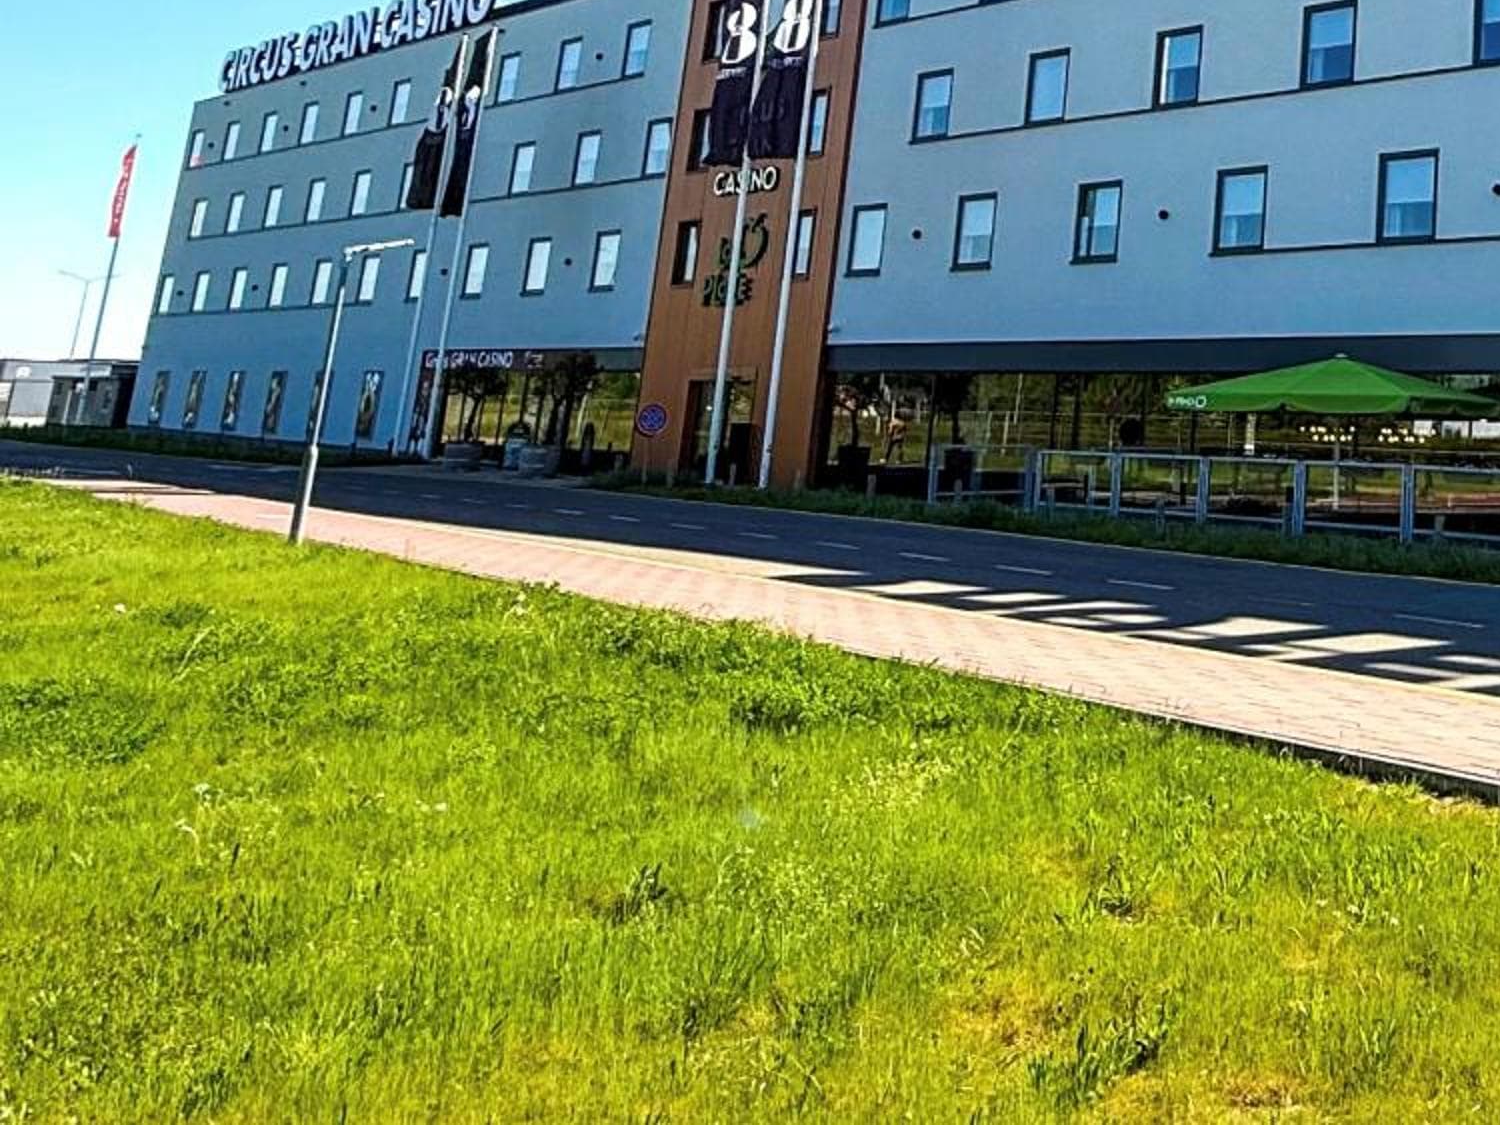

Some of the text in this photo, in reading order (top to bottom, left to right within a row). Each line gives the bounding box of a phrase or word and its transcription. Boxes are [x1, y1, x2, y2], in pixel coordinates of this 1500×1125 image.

[219, 33, 299, 93] CIRCUS
[300, 6, 379, 72] GRAN
[713, 165, 778, 196] CASNO
